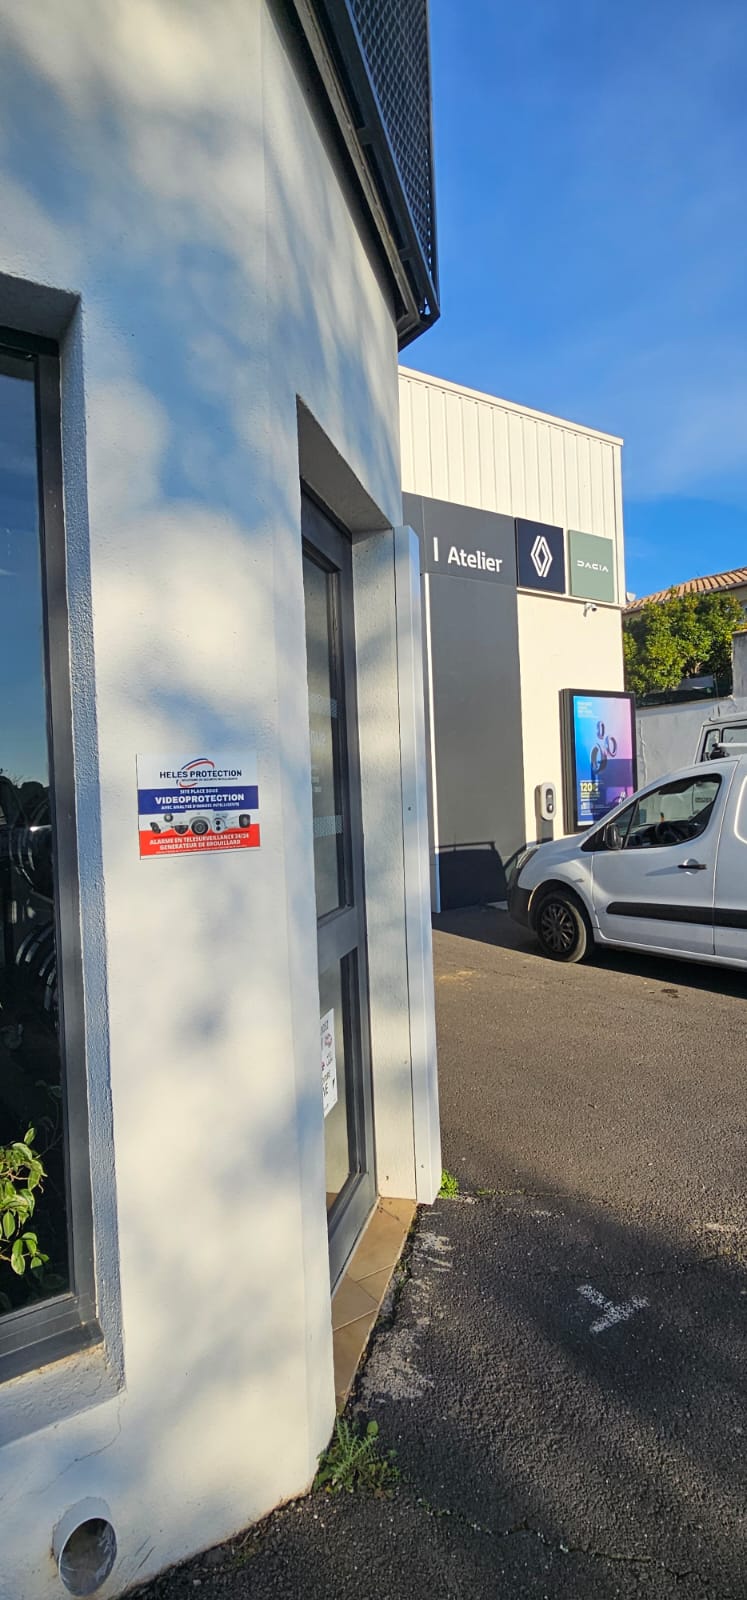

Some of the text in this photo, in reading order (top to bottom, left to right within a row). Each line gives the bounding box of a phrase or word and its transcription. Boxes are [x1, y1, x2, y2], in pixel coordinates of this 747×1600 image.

[448, 546, 503, 573] Atelier
[576, 559, 609, 573] DACIA
[155, 793, 244, 804] VIDEOPROTECTION
